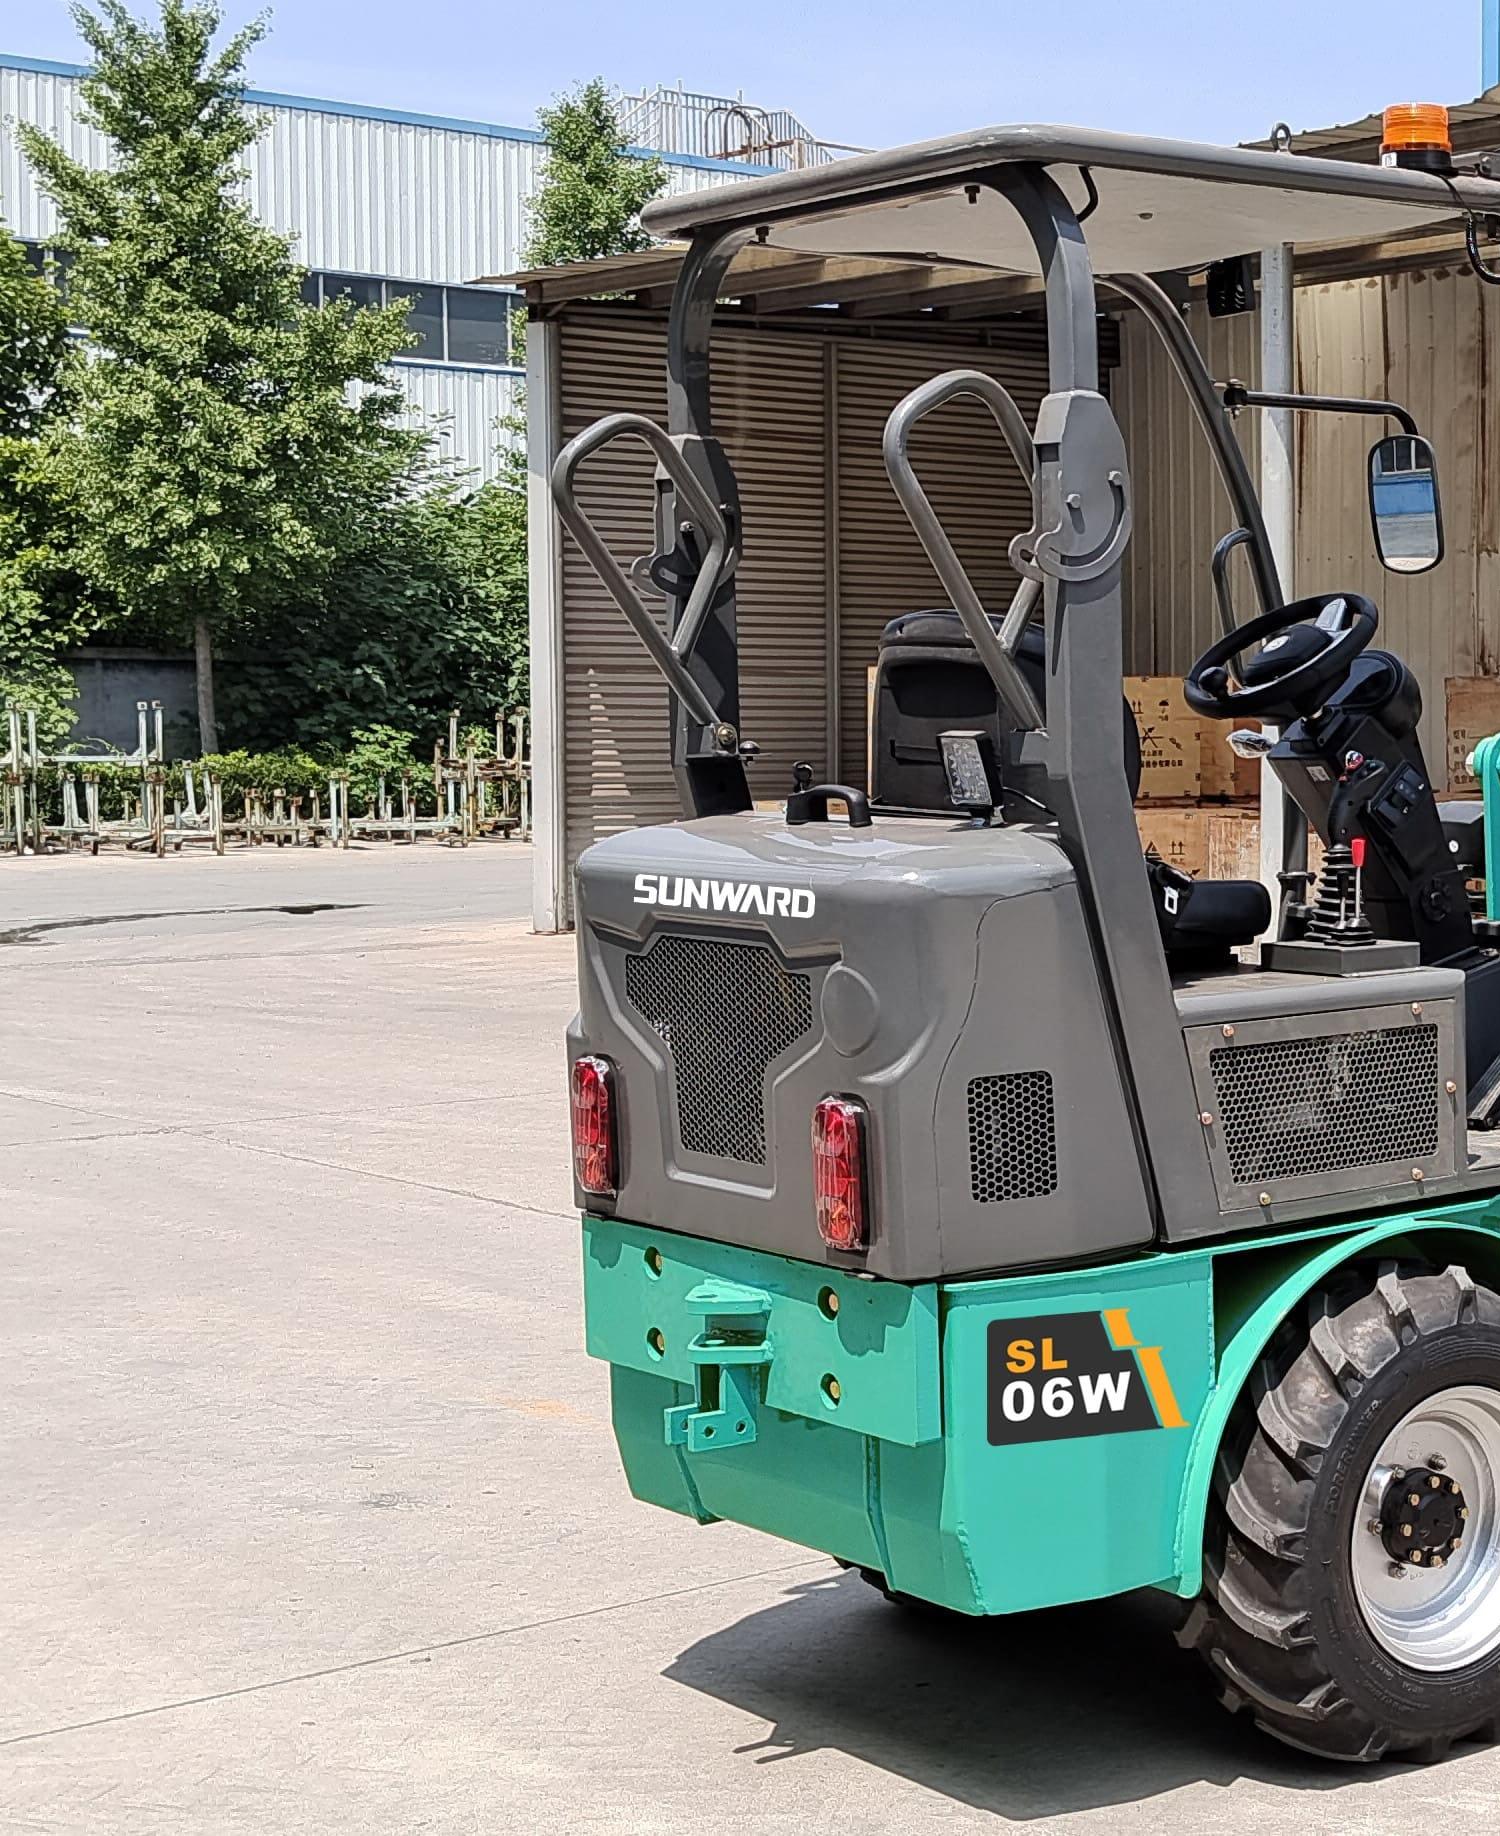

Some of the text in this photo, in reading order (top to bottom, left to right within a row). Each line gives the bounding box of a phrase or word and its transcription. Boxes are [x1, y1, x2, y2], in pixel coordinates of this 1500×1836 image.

[633, 873, 816, 919] SUNWARD
[1006, 1337, 1068, 1374] SL
[1002, 1371, 1131, 1422] 06W
